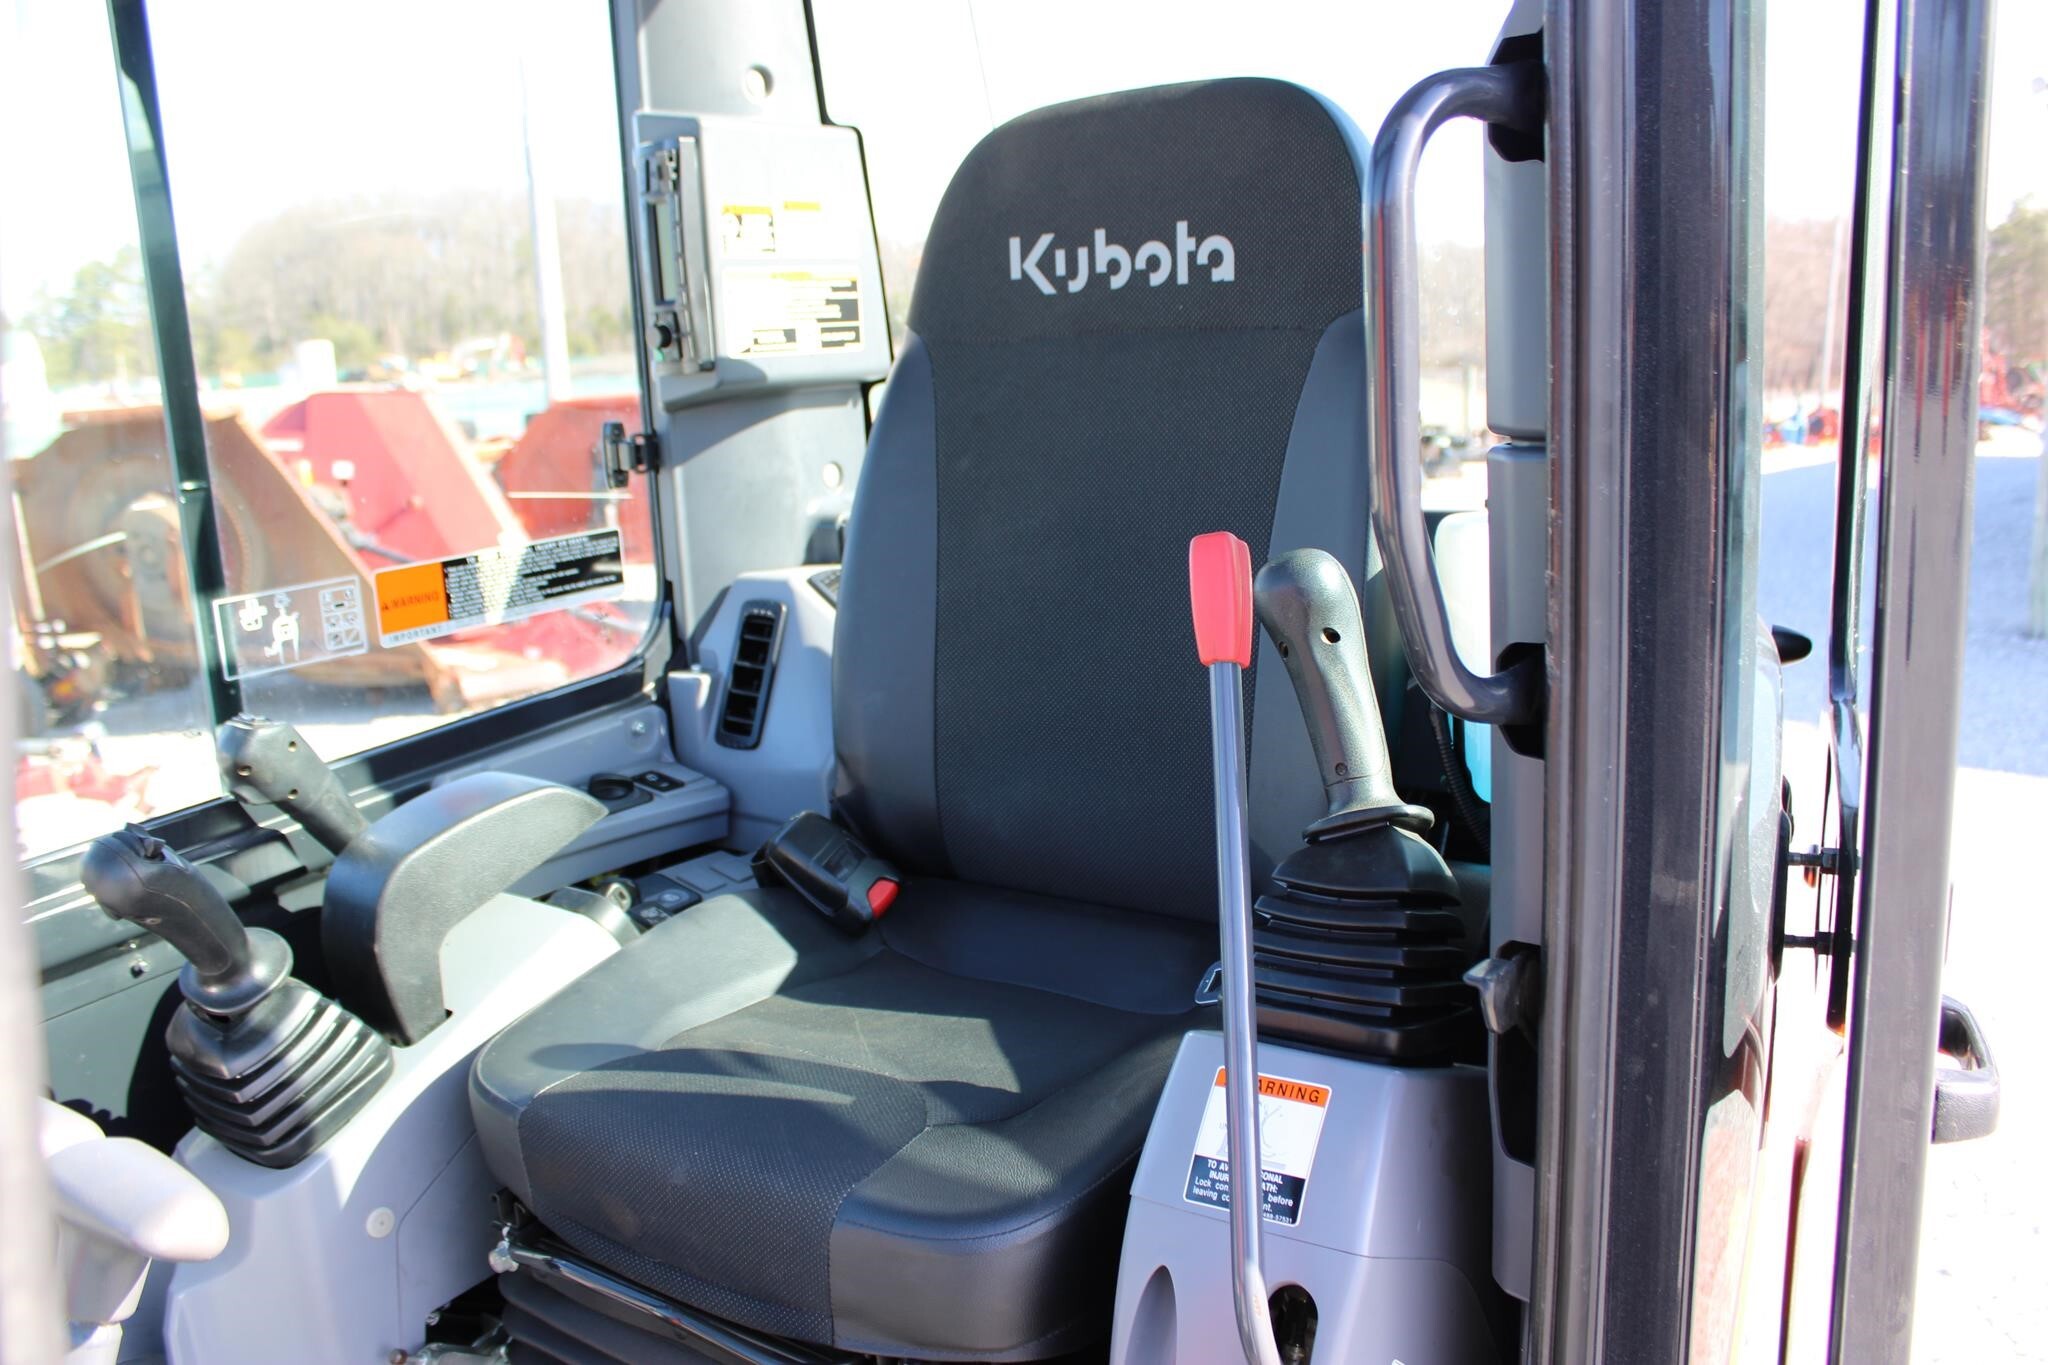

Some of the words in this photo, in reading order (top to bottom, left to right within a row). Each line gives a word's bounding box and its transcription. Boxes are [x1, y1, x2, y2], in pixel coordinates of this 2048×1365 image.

[1009, 220, 1235, 295] Kubota
[1258, 1079, 1320, 1103] RNING
[1207, 1159, 1217, 1169] TO
[1192, 1186, 1218, 1201] leaving
[1195, 1176, 1211, 1188] Lock
[1268, 1193, 1294, 1207] before
[1209, 1170, 1230, 1182] INJUR
[1261, 1182, 1279, 1194] ATH:
